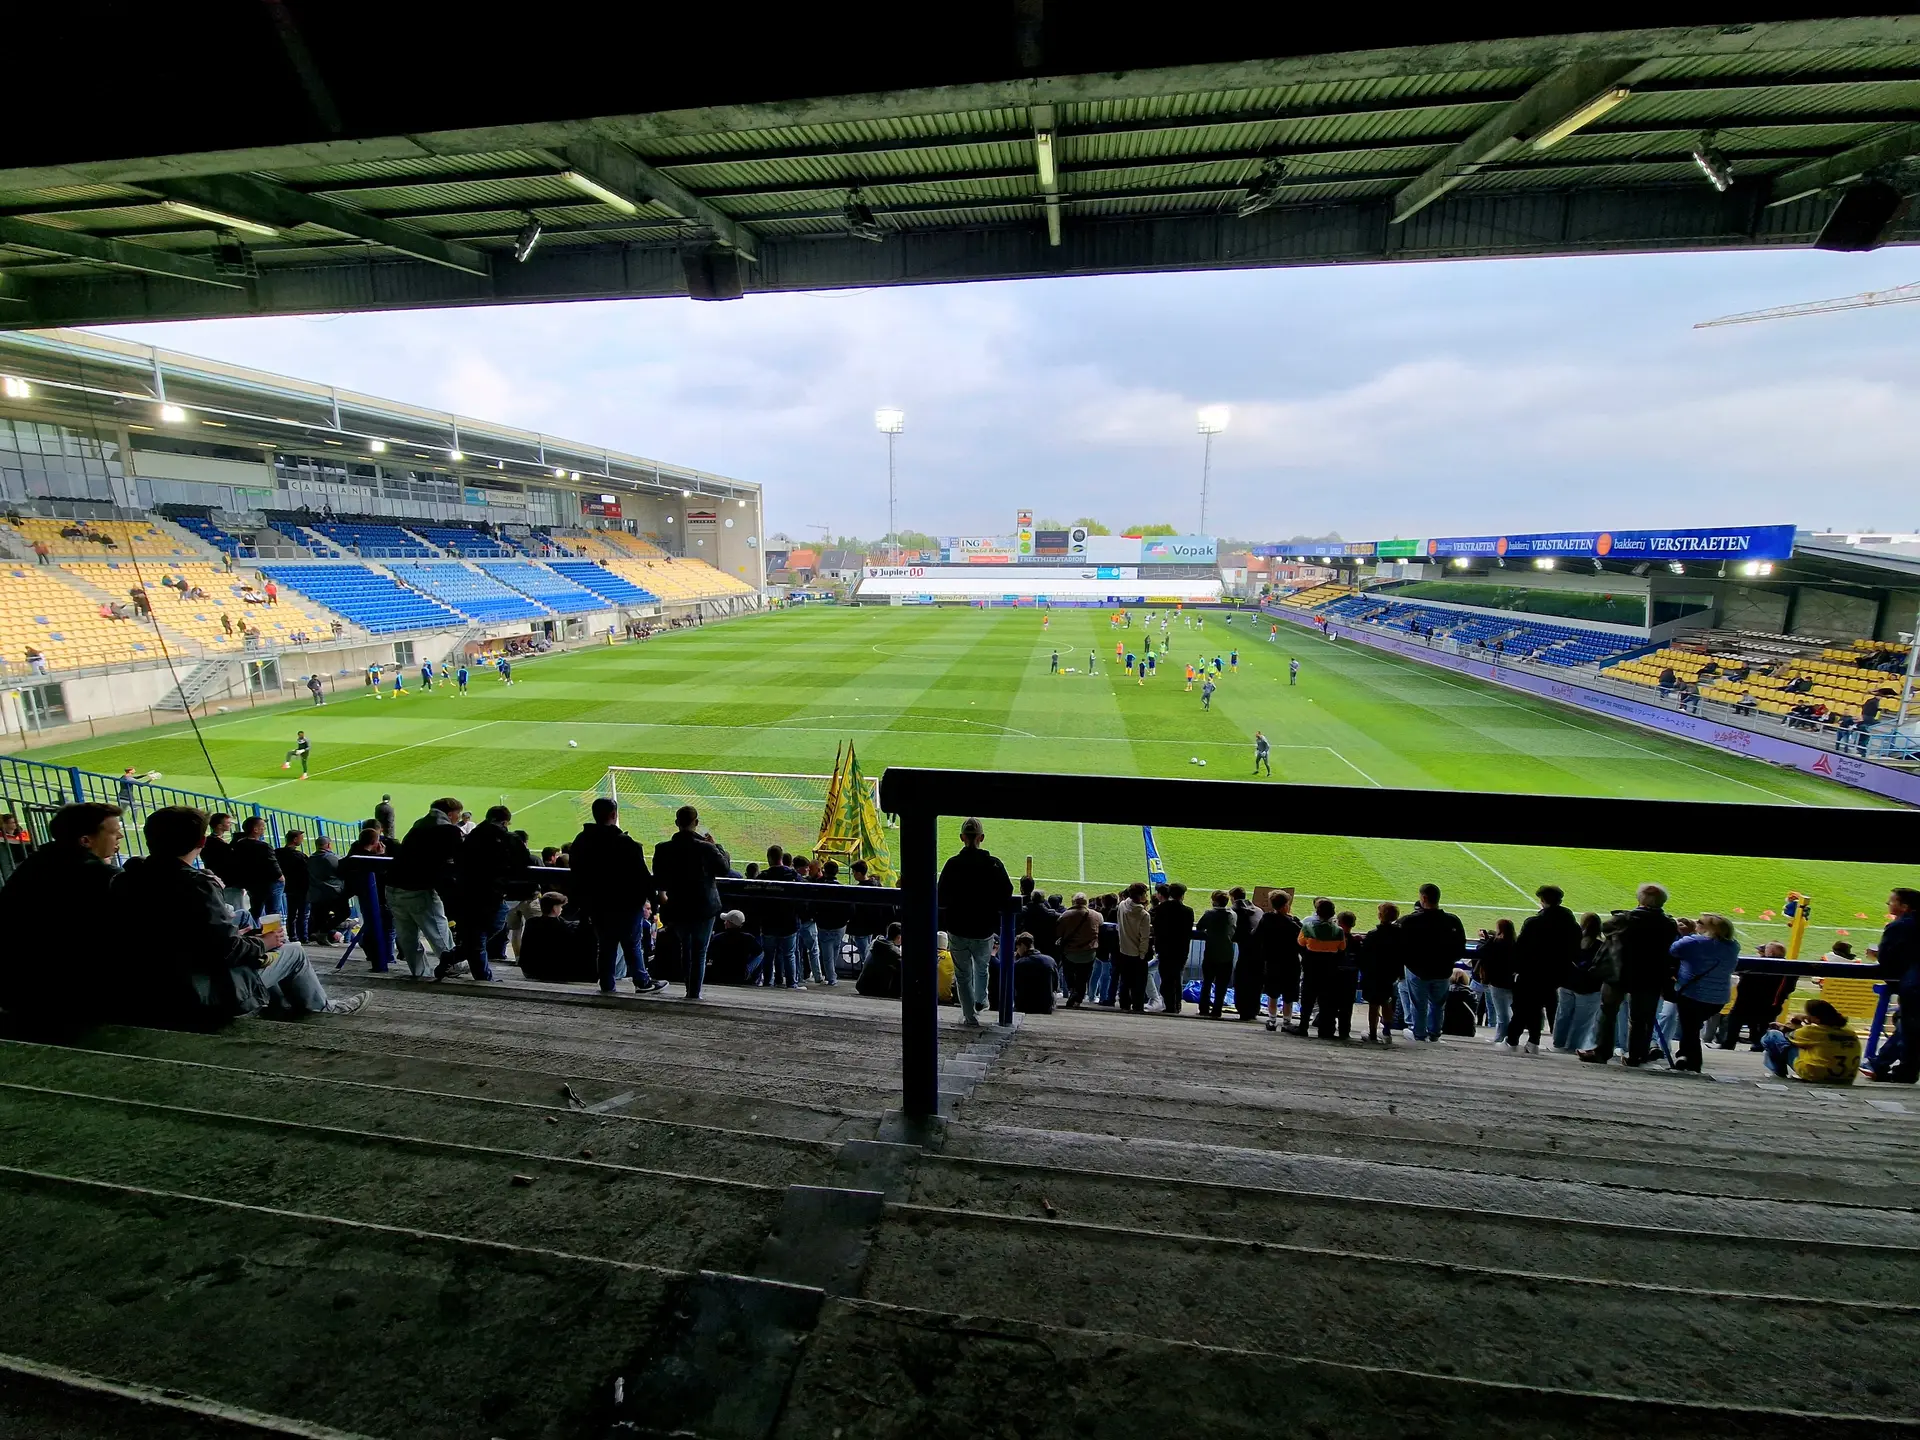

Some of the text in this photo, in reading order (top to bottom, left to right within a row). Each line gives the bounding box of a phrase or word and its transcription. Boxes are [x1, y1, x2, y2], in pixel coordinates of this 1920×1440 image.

[291, 481, 368, 496] CALLANT
[1453, 541, 1496, 552] VERSTRAETEN
[1532, 538, 1594, 551] VERSTRAETEN
[1613, 536, 1751, 552] bakkerij VERSTRAETEN
[1172, 545, 1214, 557] Vopak
[880, 568, 908, 577] Jupiler
[1839, 757, 1853, 767] Port
